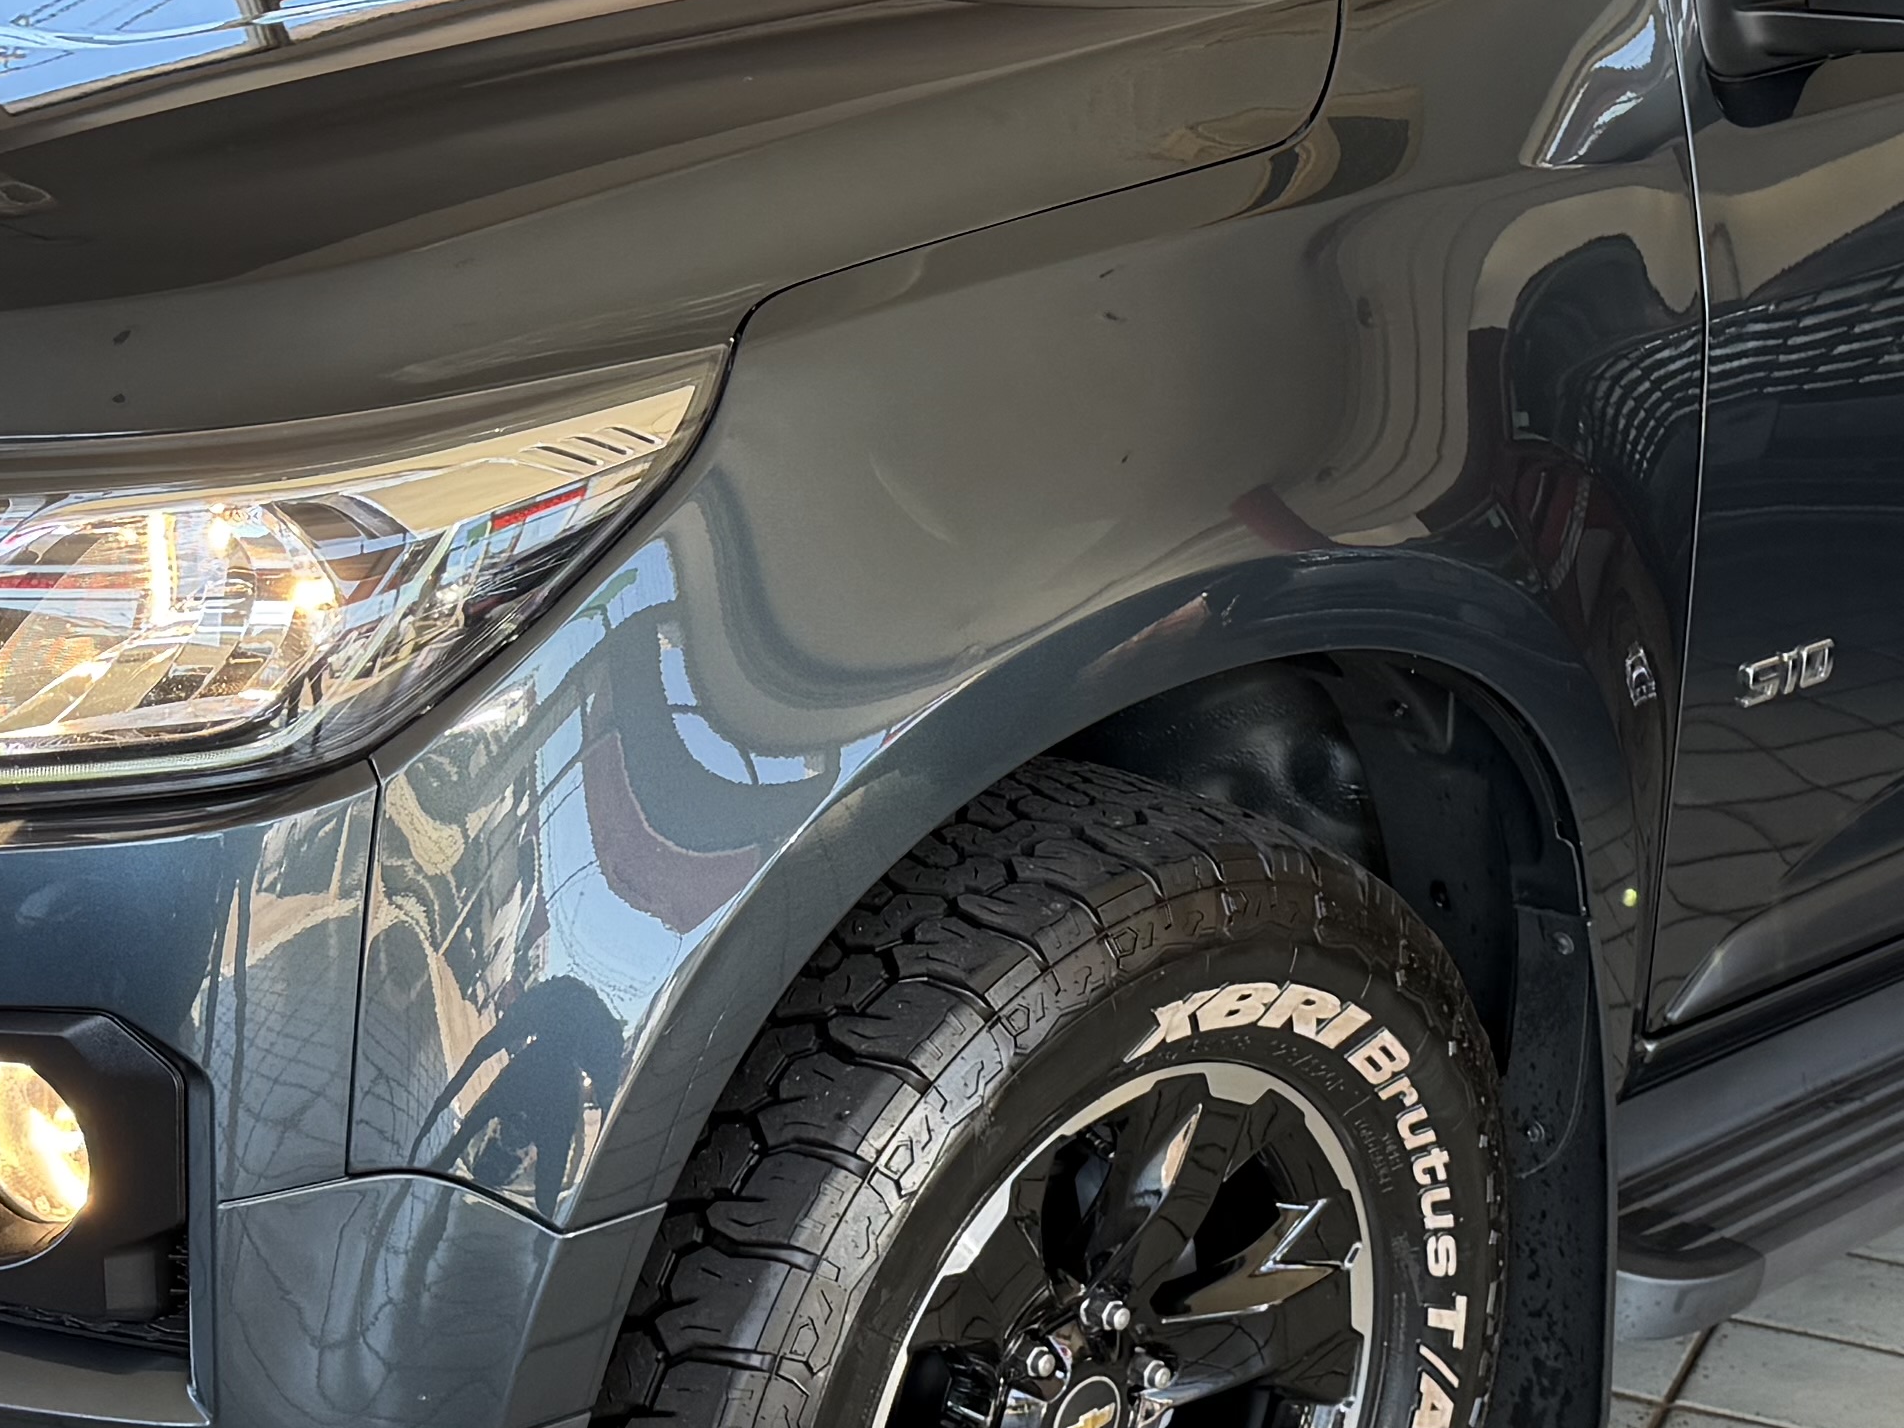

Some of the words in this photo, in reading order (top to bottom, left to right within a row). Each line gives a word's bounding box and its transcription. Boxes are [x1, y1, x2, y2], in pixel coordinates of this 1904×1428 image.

[1734, 638, 1835, 708] S10
[1123, 980, 1372, 1063] XBRI
[1344, 1026, 1459, 1280] Brutus
